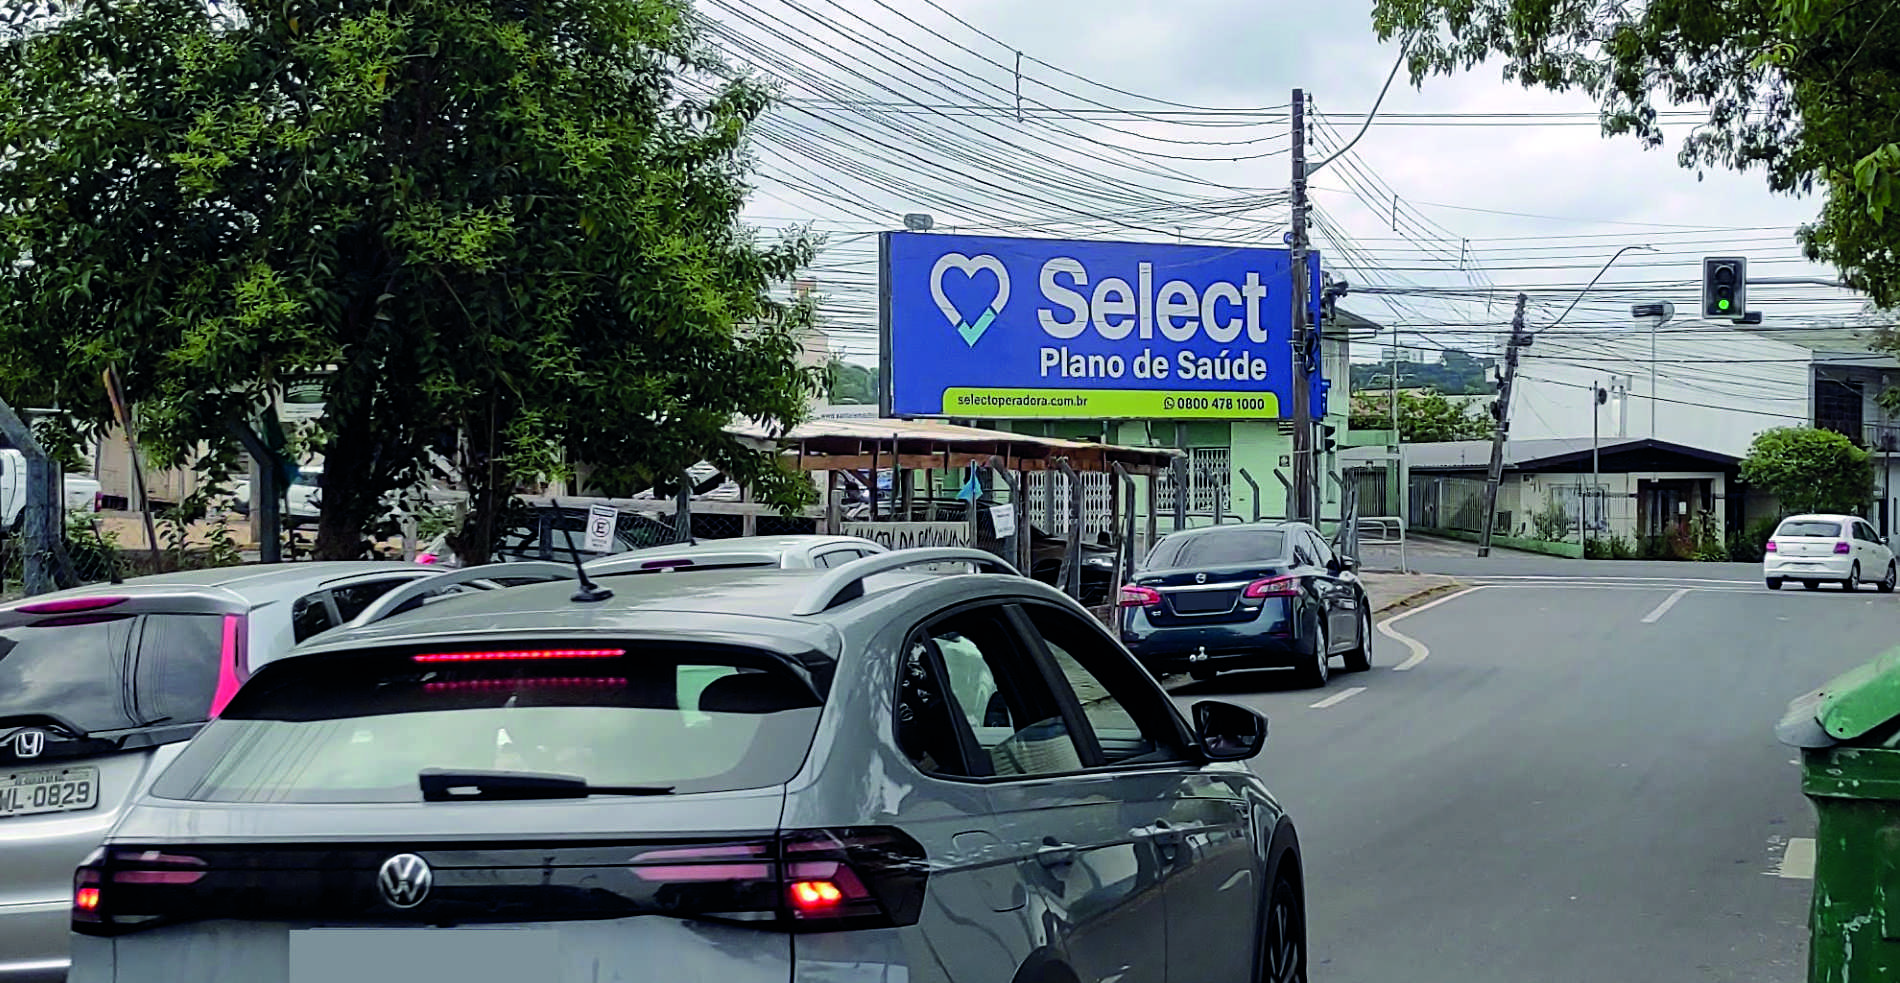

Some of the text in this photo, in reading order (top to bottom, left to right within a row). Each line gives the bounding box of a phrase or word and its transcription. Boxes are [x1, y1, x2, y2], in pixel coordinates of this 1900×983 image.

[1037, 256, 1267, 343] Select
[1040, 346, 1267, 381] Plano de Saúde
[957, 393, 1088, 408] selectoperadora.com.br
[1177, 397, 1265, 411] 0800 478 1000
[596, 522, 606, 534] E
